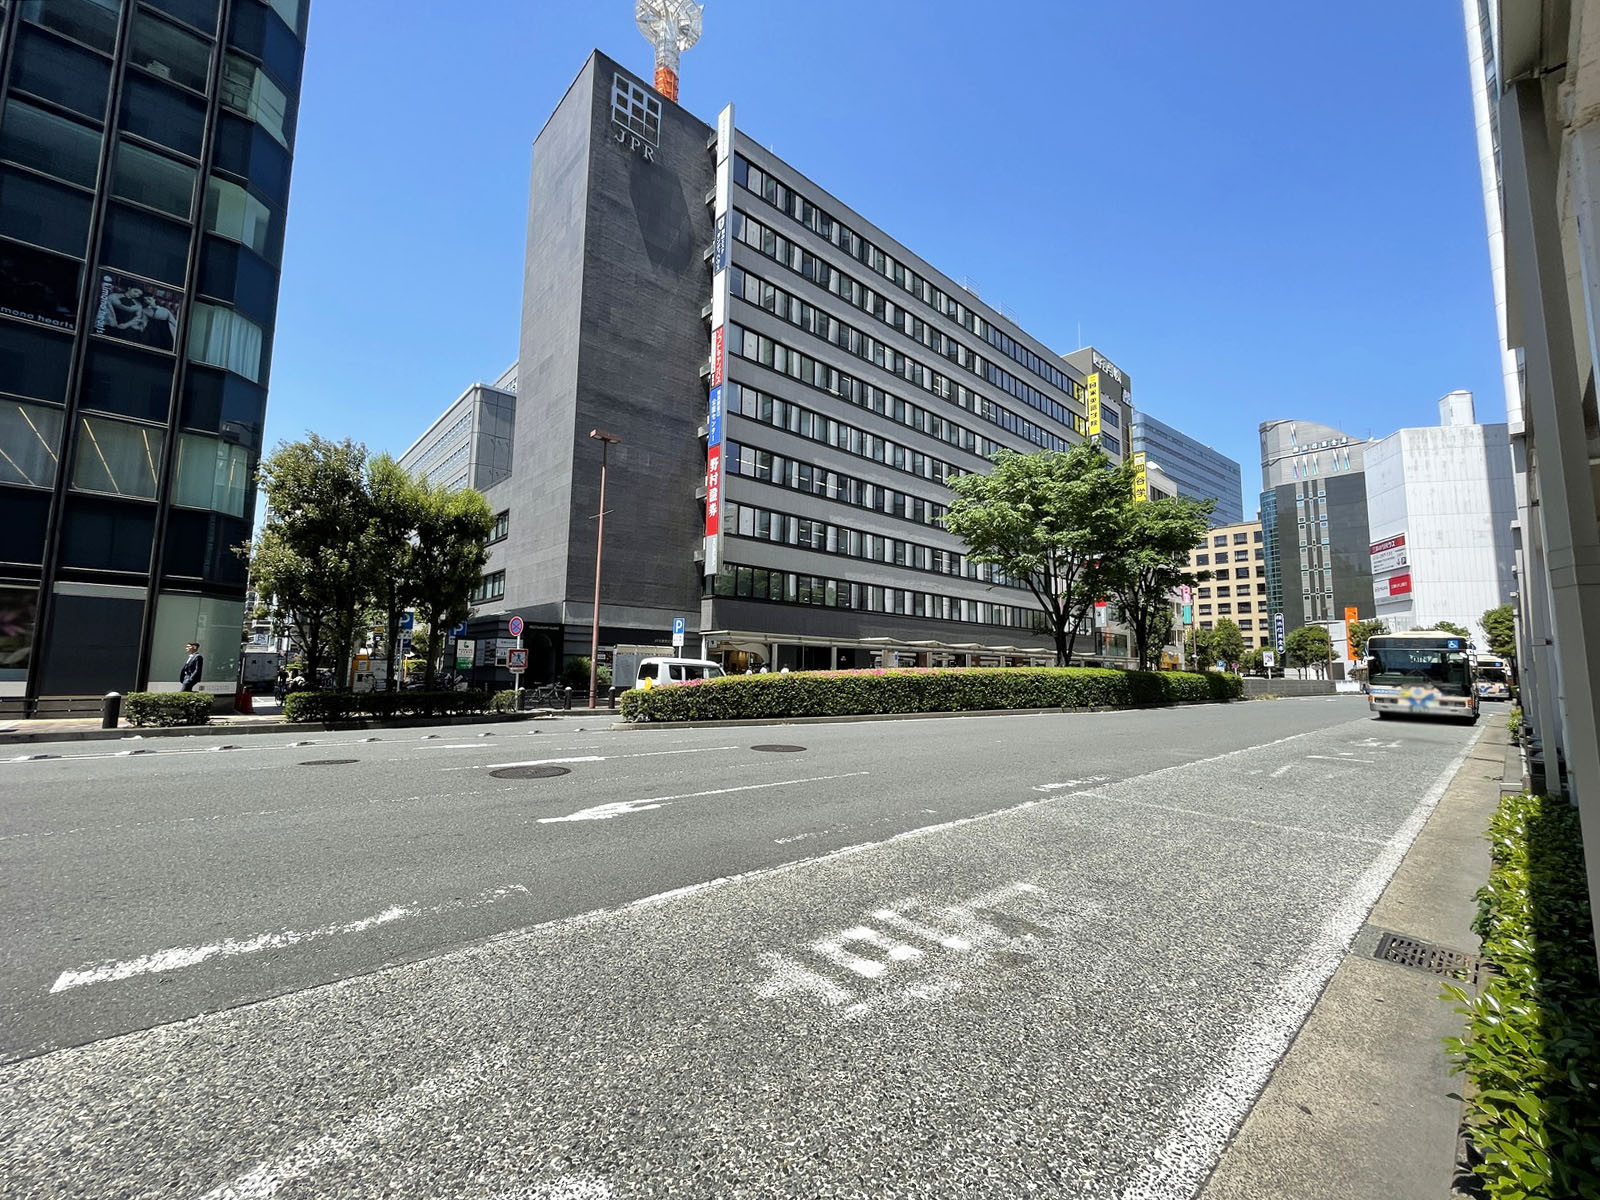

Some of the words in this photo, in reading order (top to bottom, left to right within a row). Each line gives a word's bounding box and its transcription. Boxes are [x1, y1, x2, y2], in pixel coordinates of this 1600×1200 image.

[614, 129, 654, 162] JPR
[0, 306, 34, 319] mono
[38, 314, 74, 329] hearts
[676, 620, 682, 633] P
